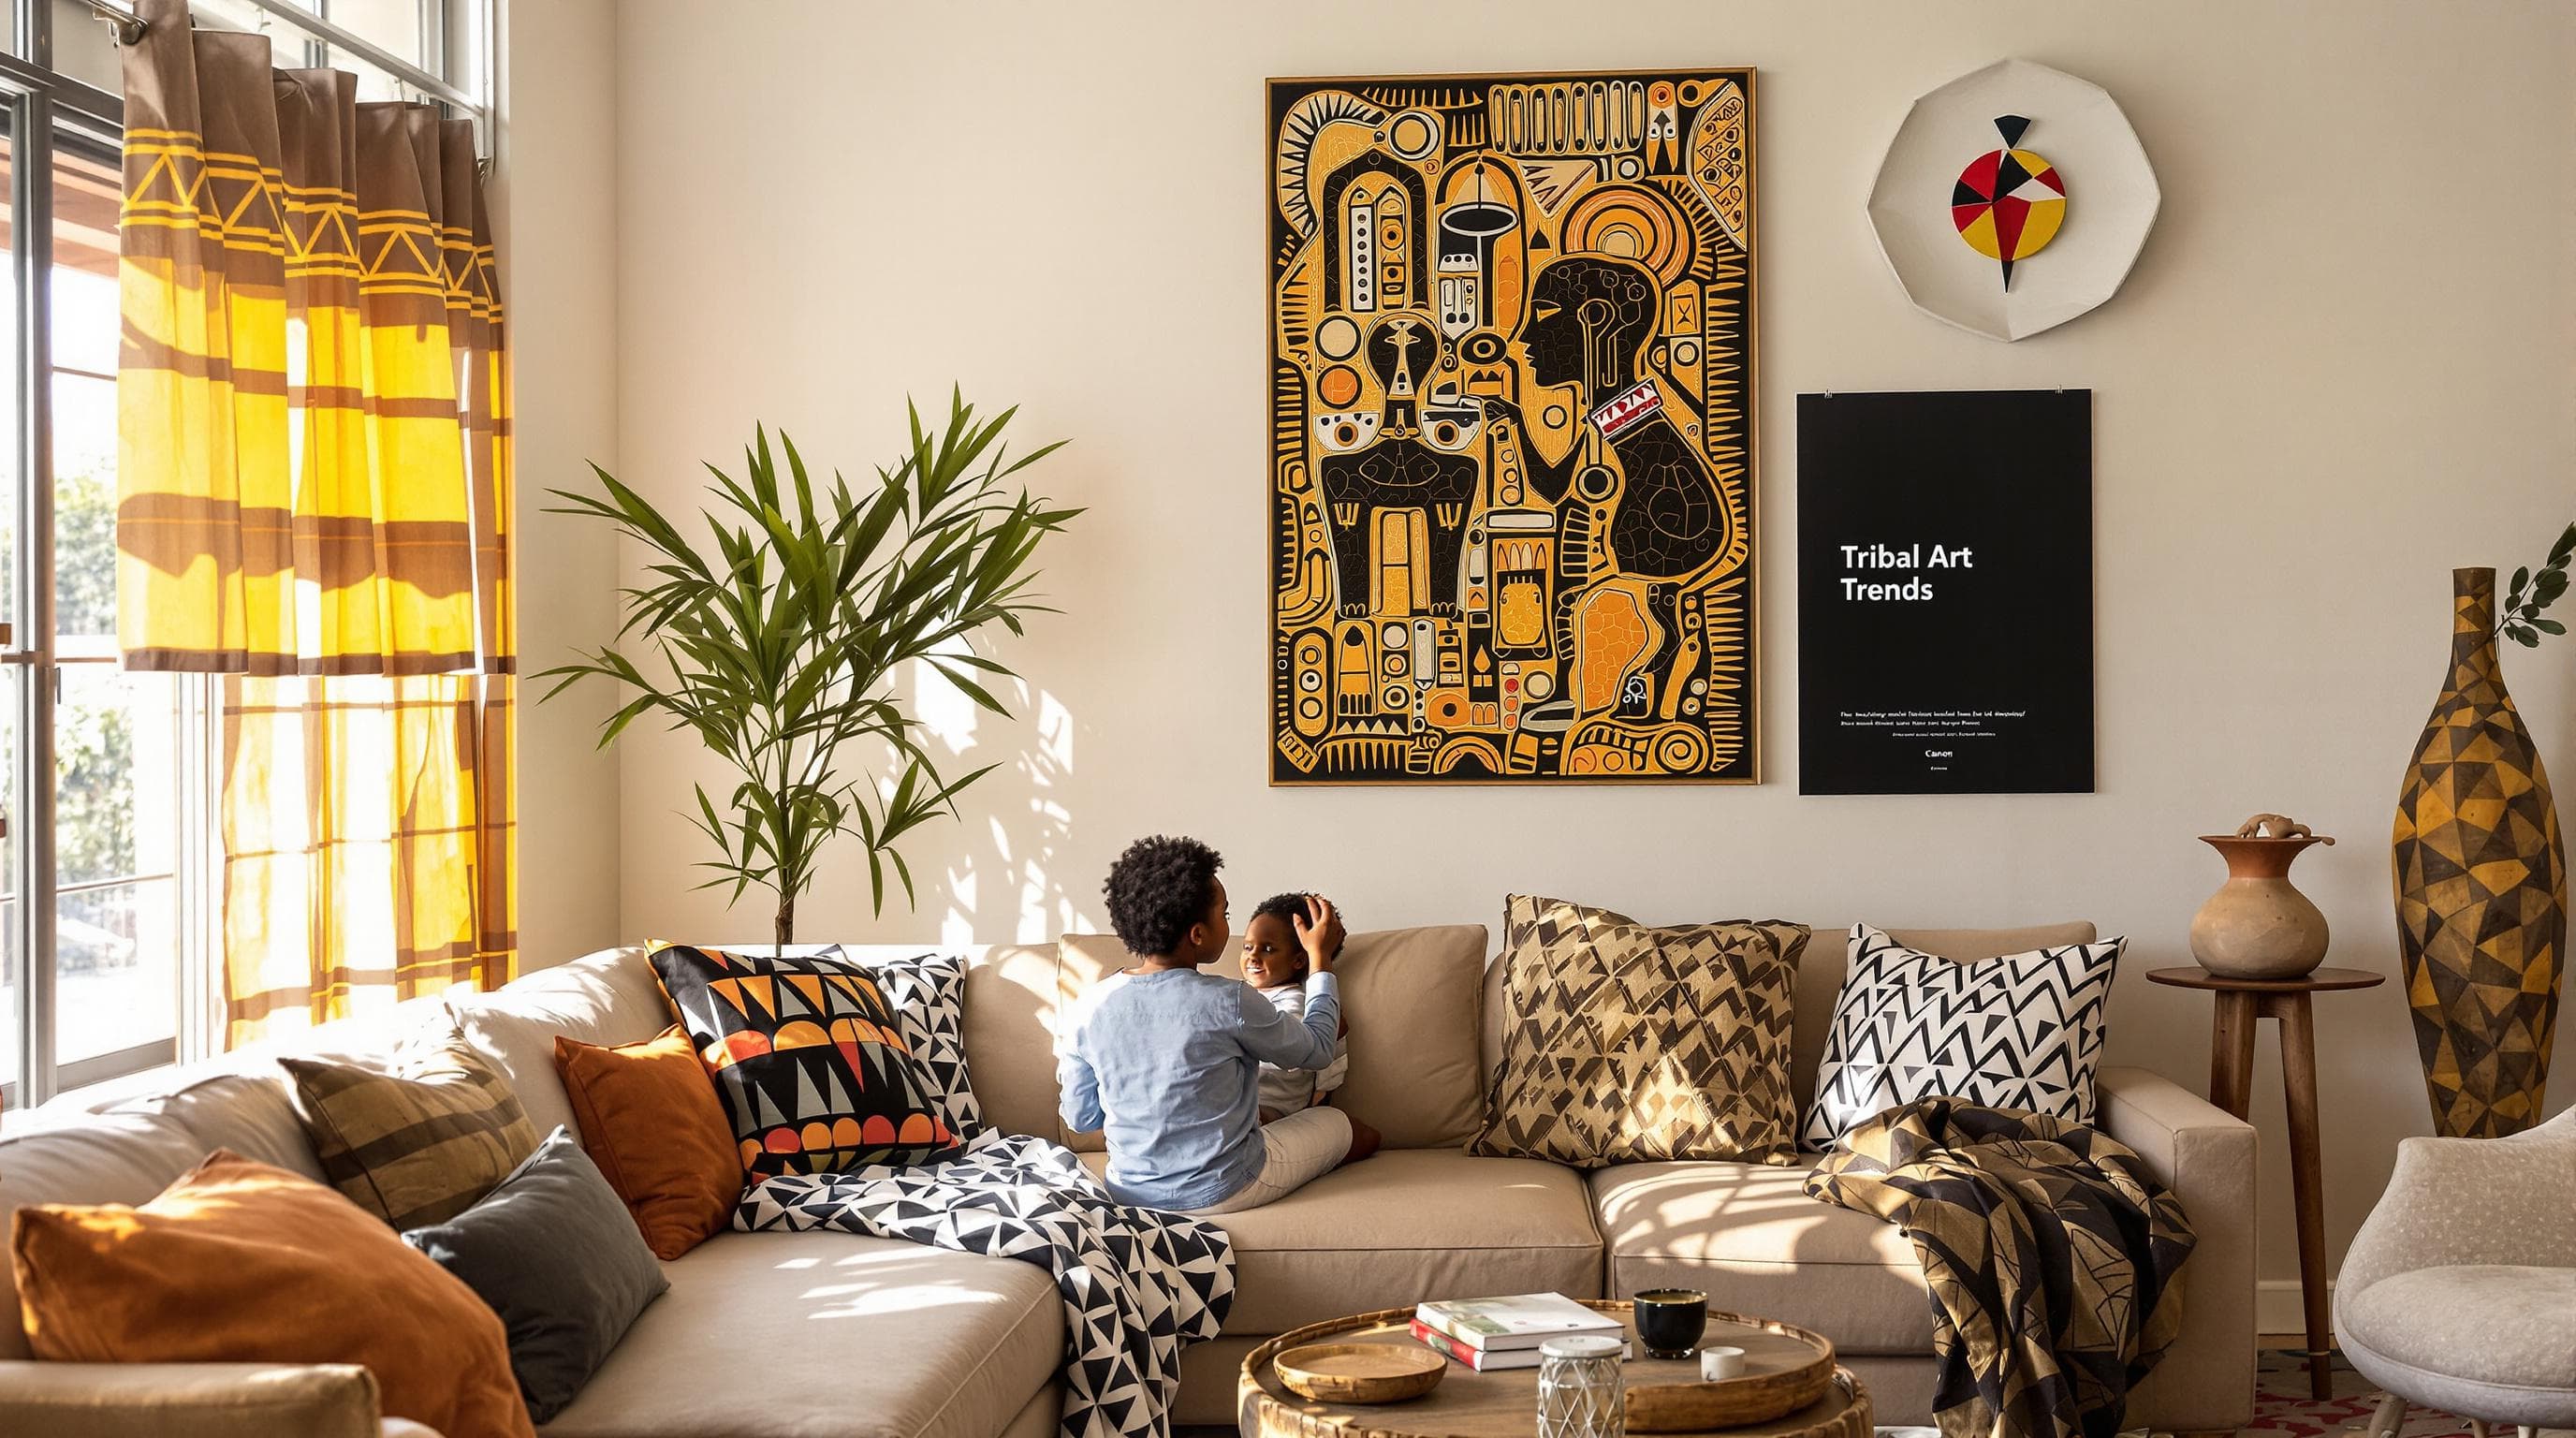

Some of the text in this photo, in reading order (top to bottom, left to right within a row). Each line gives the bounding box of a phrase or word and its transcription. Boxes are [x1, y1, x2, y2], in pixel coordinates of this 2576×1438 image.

[1840, 543, 1973, 568] Tribal Art
[1840, 576, 1934, 601] Trends
